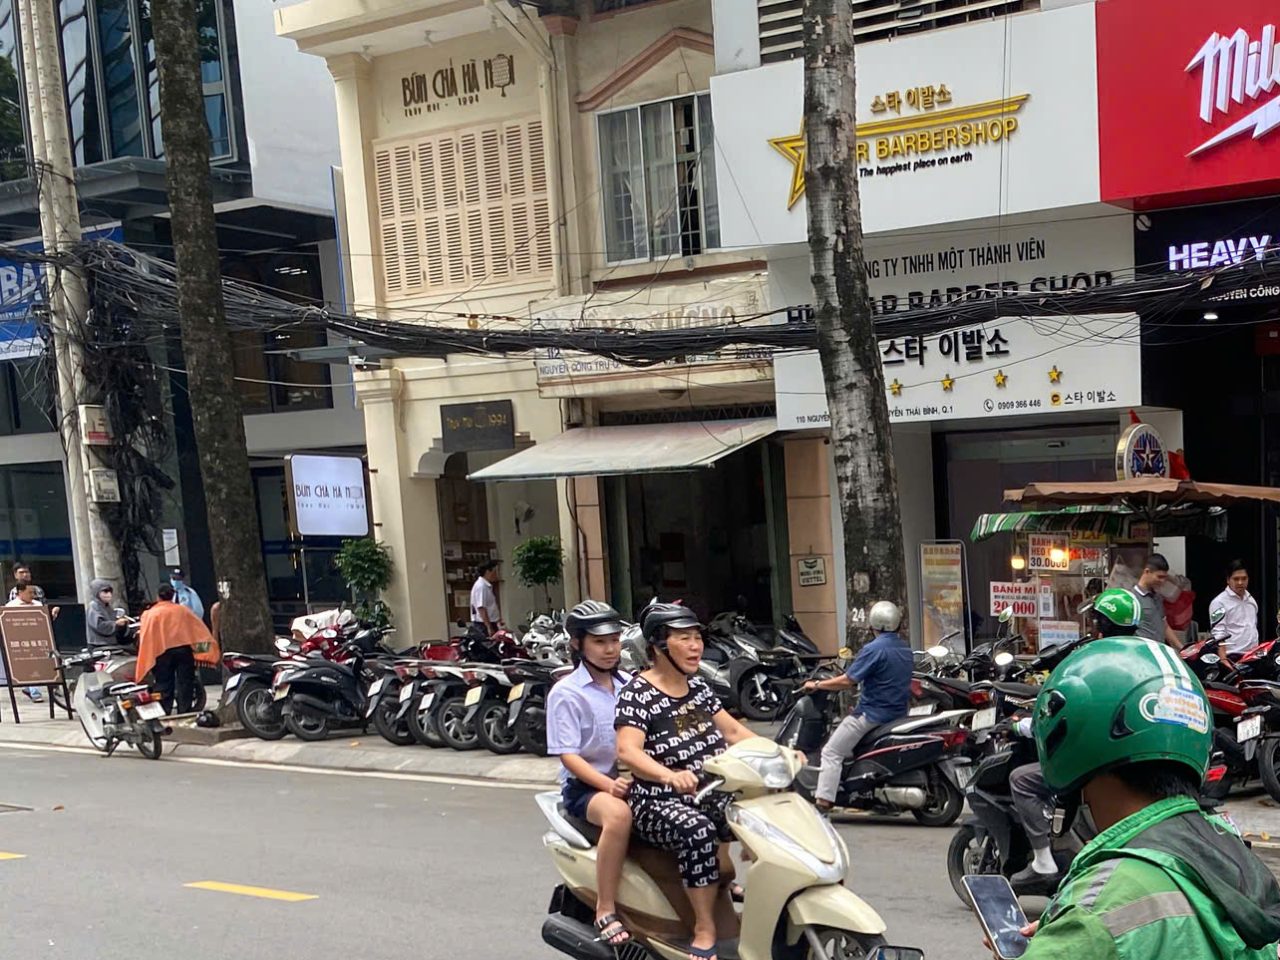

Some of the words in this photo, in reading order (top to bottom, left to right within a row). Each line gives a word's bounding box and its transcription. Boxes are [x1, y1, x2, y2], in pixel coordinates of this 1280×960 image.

[870, 94, 902, 114] 스타
[905, 83, 953, 110] 이발소
[876, 117, 1018, 160] BARBERSHOP
[859, 167, 874, 177] The
[876, 160, 911, 176] happiest
[913, 158, 936, 171] place
[937, 156, 949, 166] on
[950, 151, 972, 164] earth
[866, 260, 880, 280] NG
[883, 258, 899, 277] TY
[901, 252, 934, 274] TNHH
[938, 246, 966, 273] MỘT
[968, 242, 1012, 267] THÀNH
[1015, 238, 1046, 261] VIÊN
[1168, 233, 1271, 271] HEAVY
[1249, 284, 1280, 298] CÔNG
[882, 339, 926, 365] 스타
[938, 328, 1009, 362] 이발소
[997, 401, 1016, 411] 0909
[1030, 399, 1042, 408] 446
[1064, 393, 1084, 405] 스타
[1086, 389, 1117, 403] 이발소
[905, 406, 921, 417] THÁI
[992, 583, 1022, 594] BÁNH
[852, 606, 866, 622] 24
[993, 600, 1036, 615] 20000
